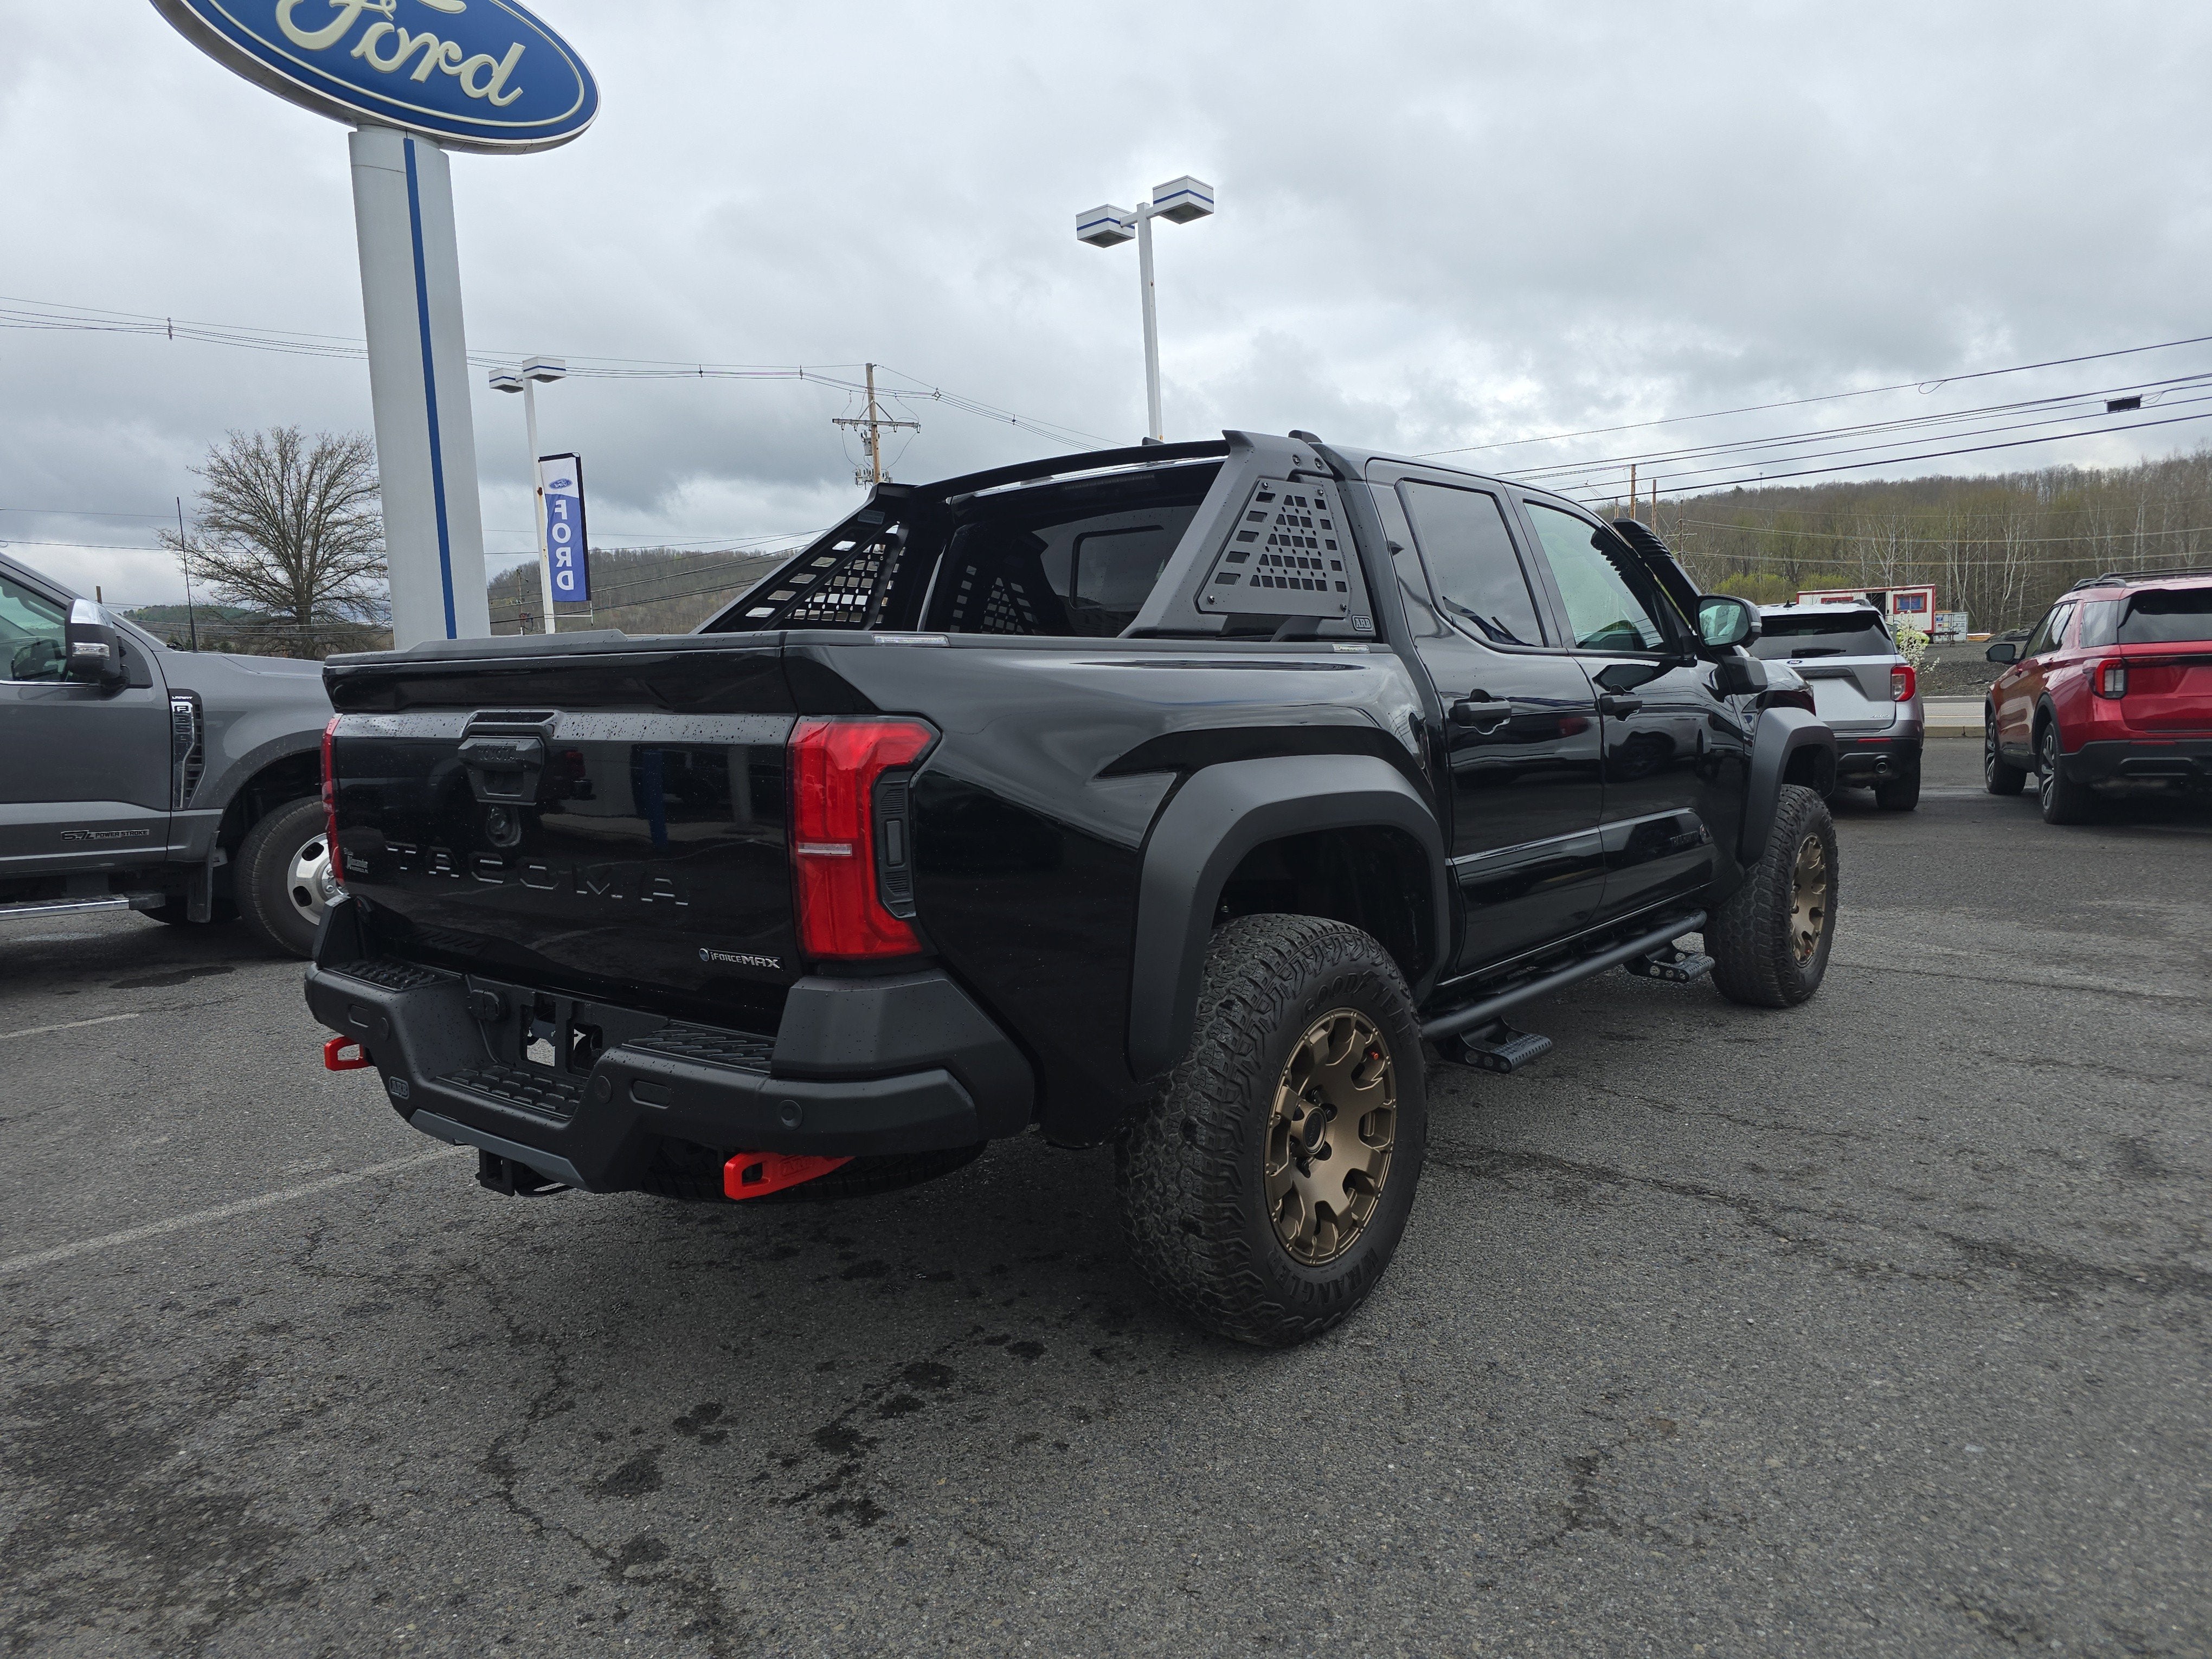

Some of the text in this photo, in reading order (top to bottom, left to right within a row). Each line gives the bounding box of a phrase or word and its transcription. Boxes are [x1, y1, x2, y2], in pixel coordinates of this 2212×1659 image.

[275, 0, 525, 107] Ford
[1355, 618, 1372, 628] ARB
[384, 840, 690, 906] TACOMA
[391, 1080, 408, 1096] ARB
[1267, 1246, 1380, 1304] WRANGLER
